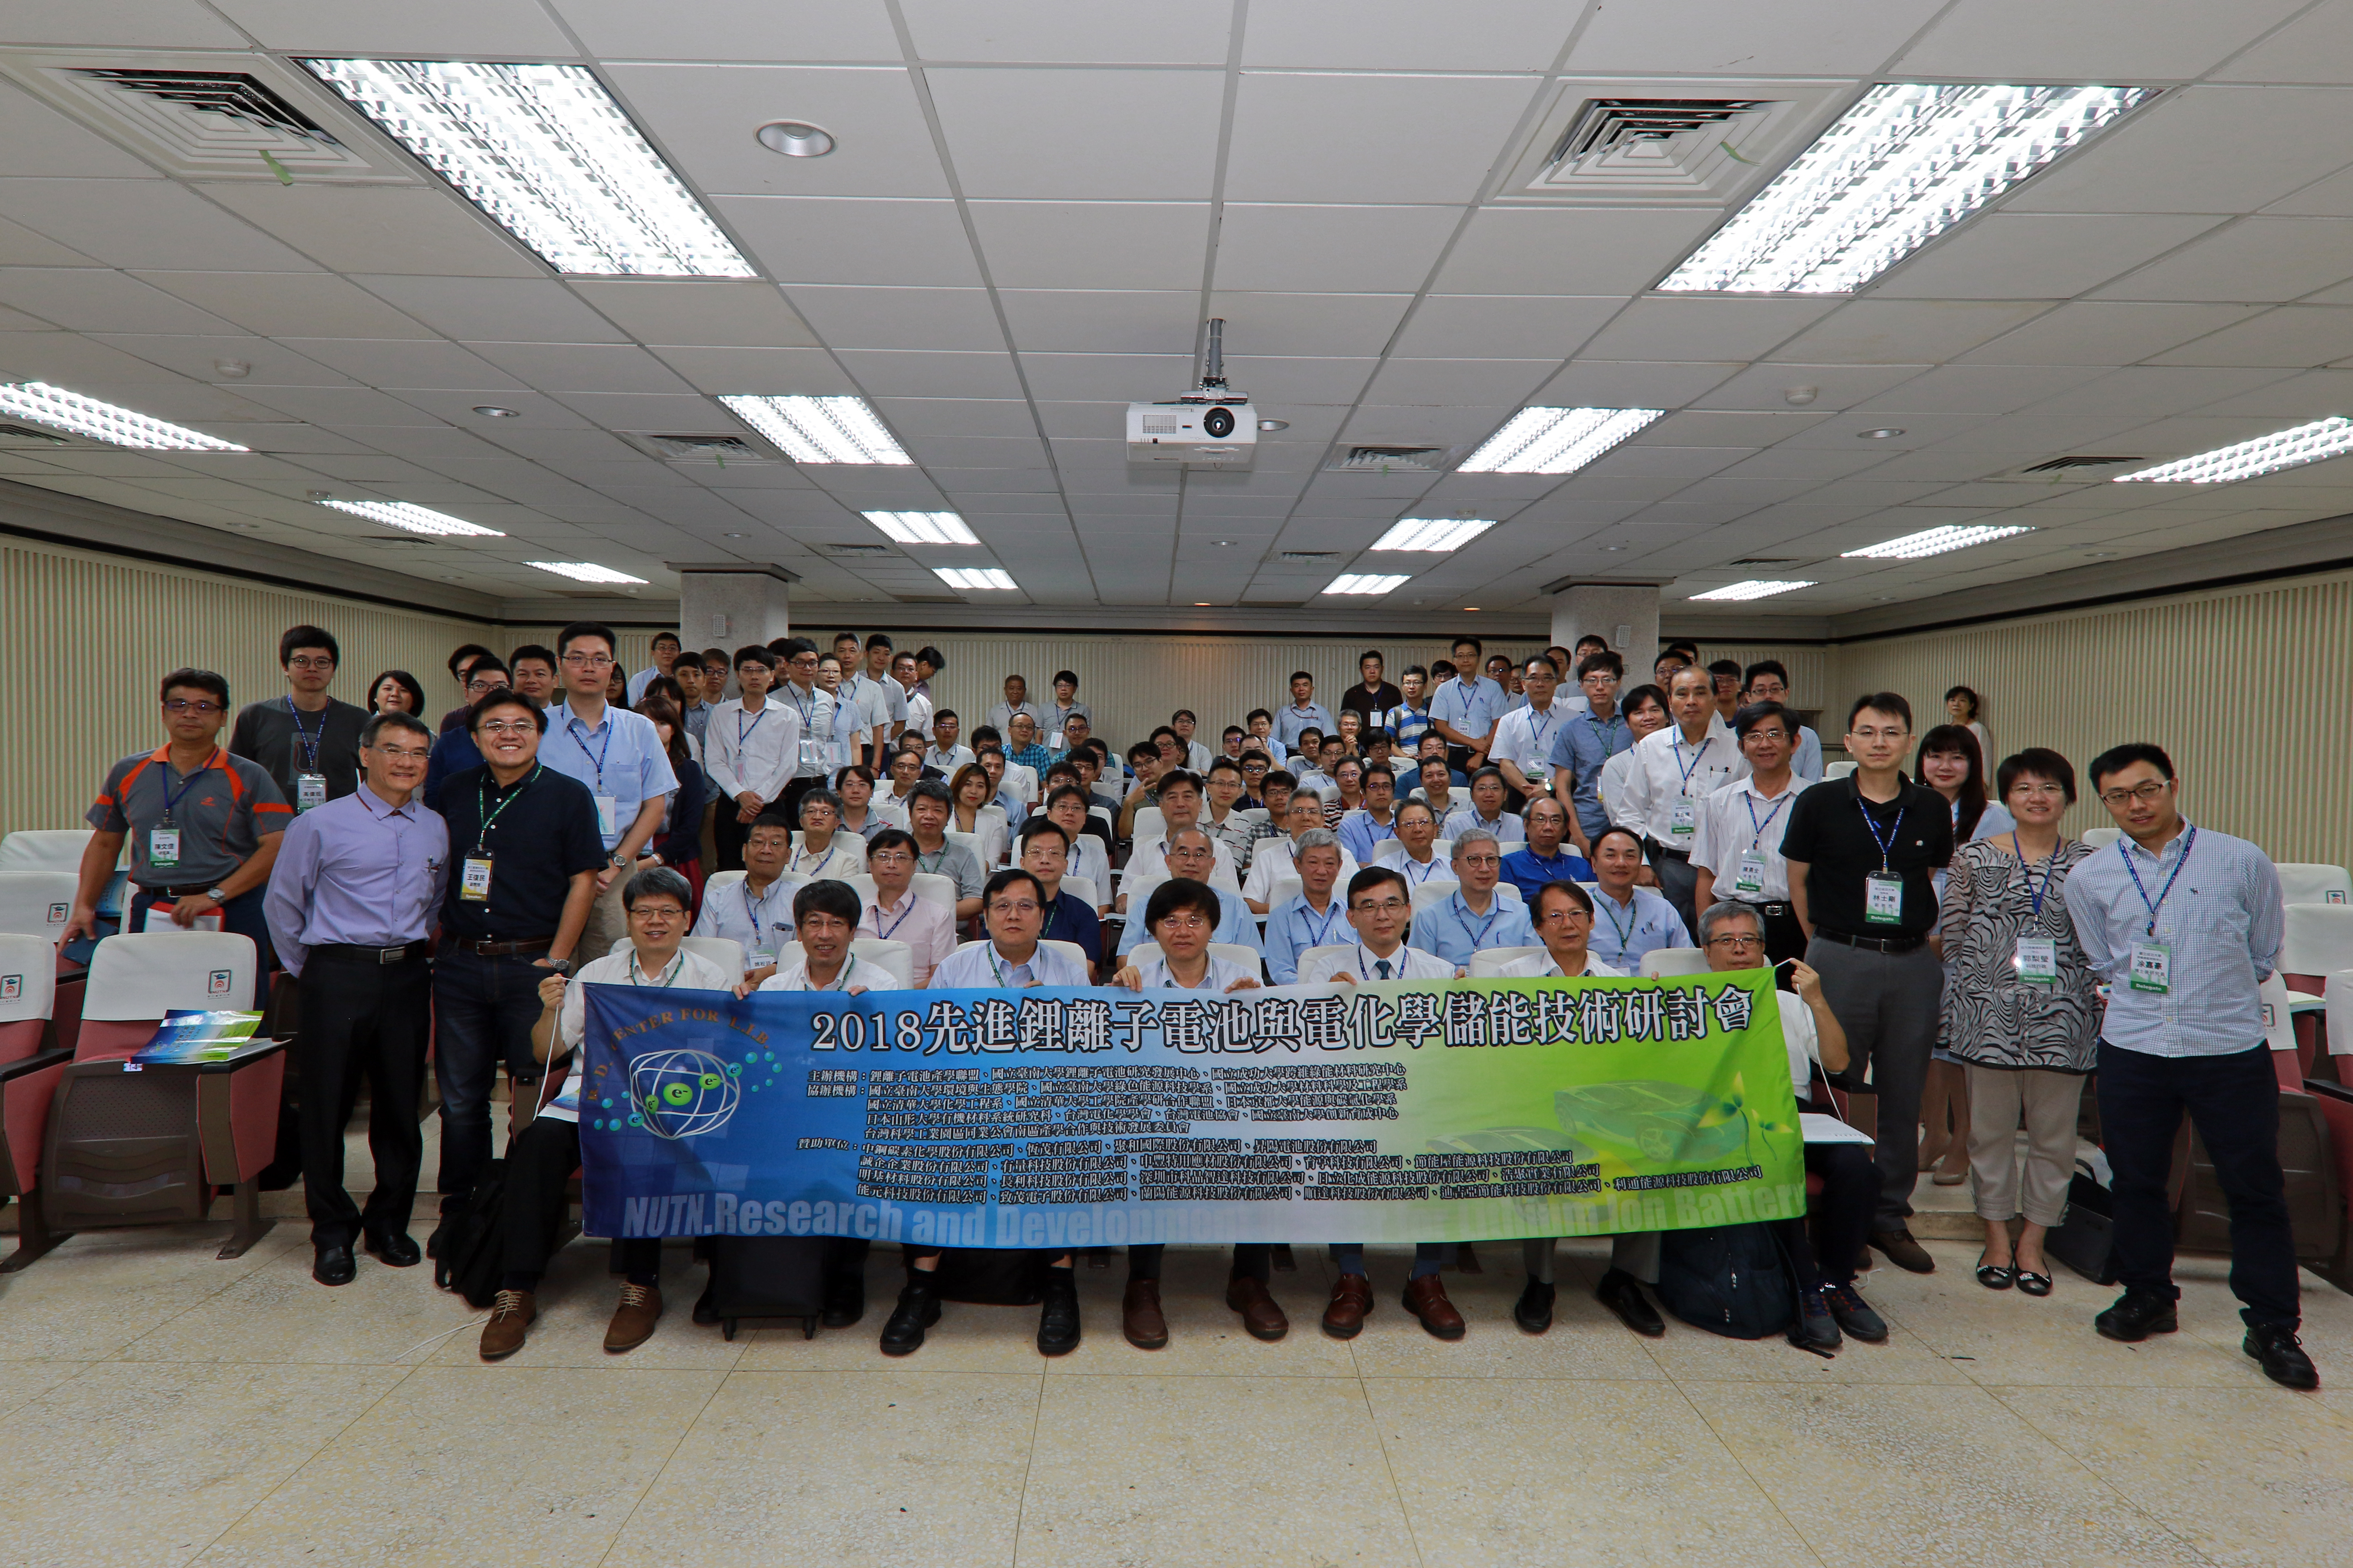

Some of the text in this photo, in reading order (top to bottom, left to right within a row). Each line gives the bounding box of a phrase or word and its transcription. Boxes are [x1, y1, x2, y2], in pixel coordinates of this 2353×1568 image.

[680, 1008, 719, 1023] FOR
[812, 985, 1754, 1055] 2018先進鋰離子電池與電化學儲能技術研討會
[622, 1193, 903, 1239] NUTN.Research
[911, 1206, 985, 1246] and
[996, 1203, 1251, 1246] Developmen
[1606, 1195, 1667, 1232] Ion
